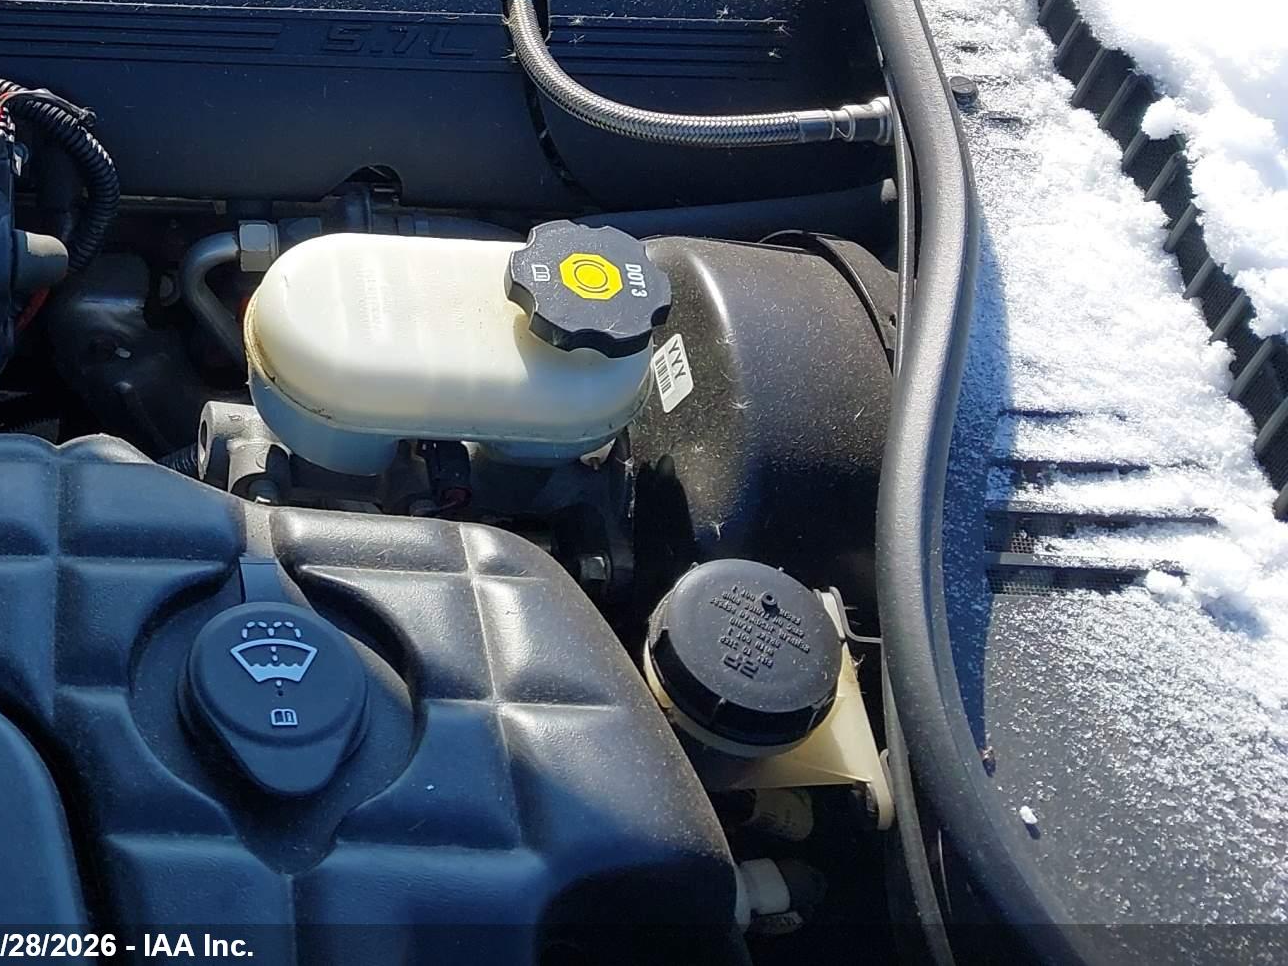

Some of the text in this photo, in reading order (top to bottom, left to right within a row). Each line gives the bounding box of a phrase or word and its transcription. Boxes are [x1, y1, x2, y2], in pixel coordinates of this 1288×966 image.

[320, 24, 475, 57] 5.7L
[624, 263, 648, 299] DOT 3
[667, 339, 687, 380] YYY
